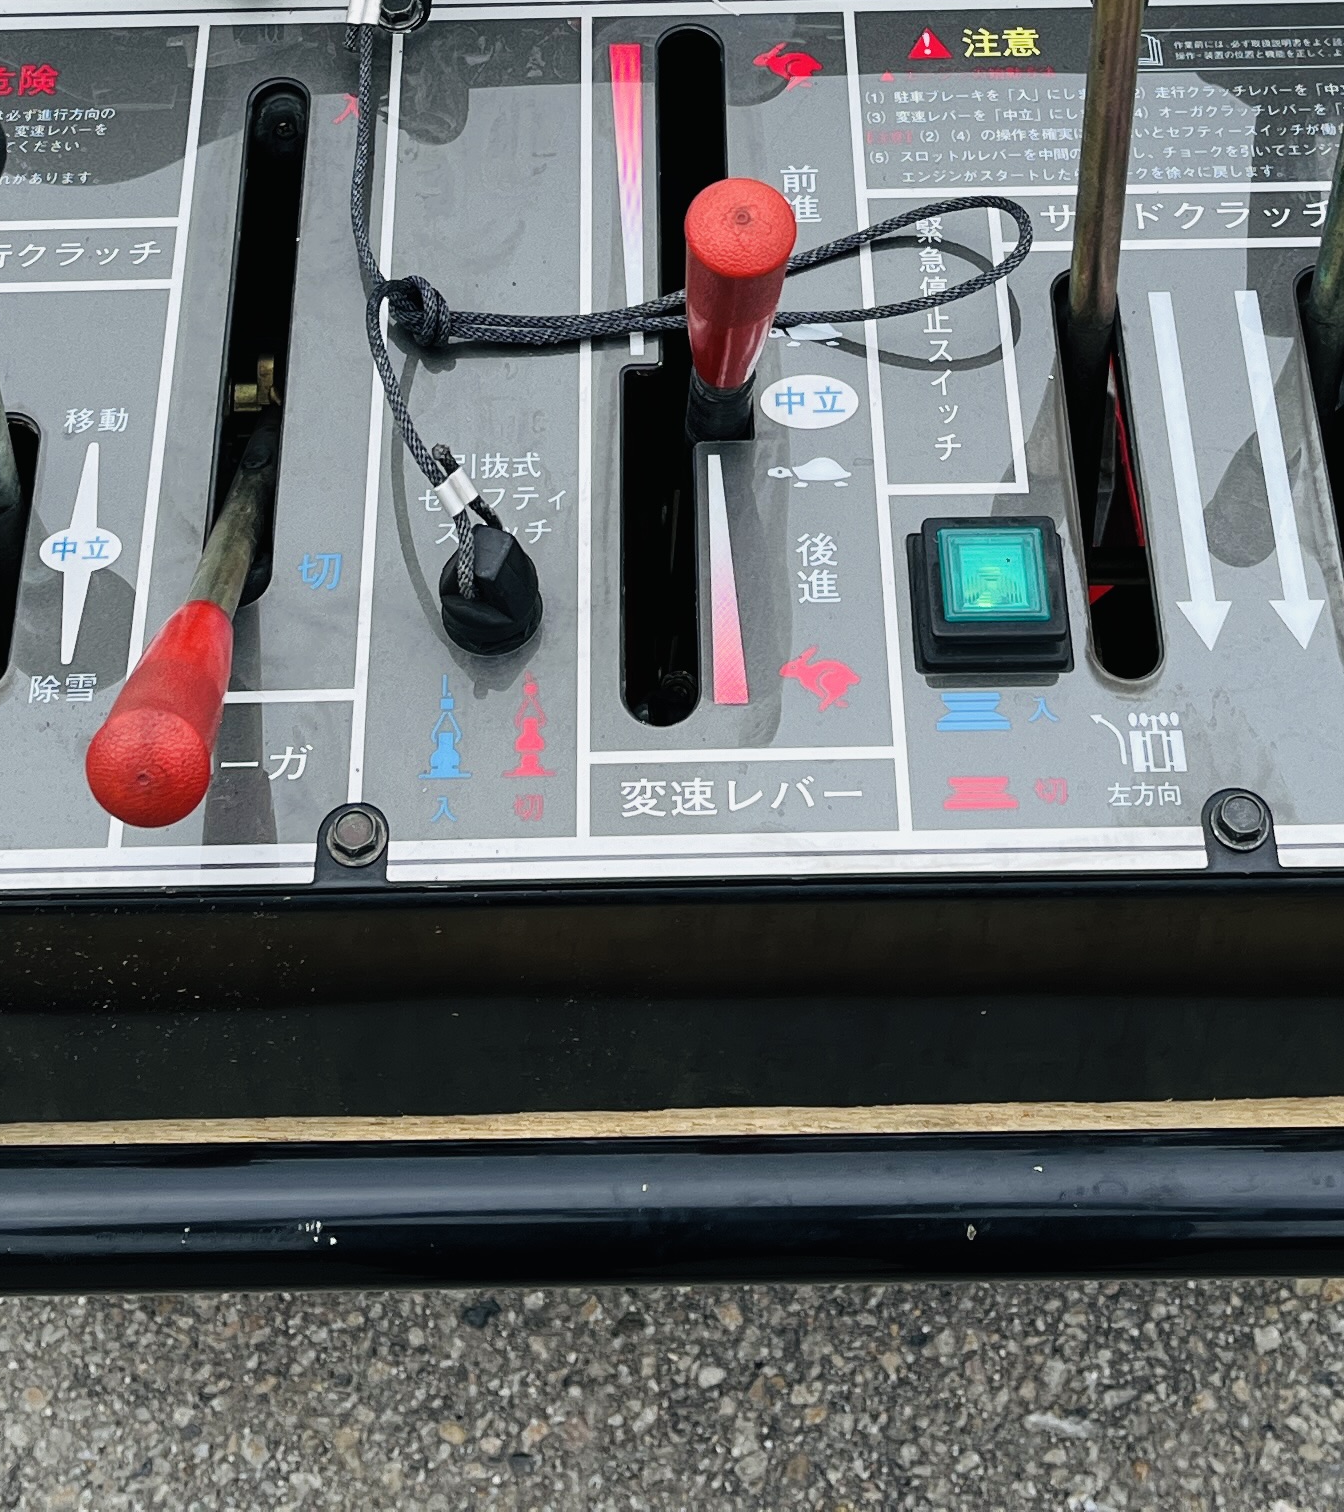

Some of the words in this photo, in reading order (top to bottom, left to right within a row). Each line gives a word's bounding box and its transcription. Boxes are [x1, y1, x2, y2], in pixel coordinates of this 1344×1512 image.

[961, 27, 1041, 58] 注意
[780, 165, 822, 223] 前進
[1040, 199, 1329, 233] サドクラッチ
[915, 217, 962, 462] 緊急停止スイッチ
[773, 386, 847, 415] 中立
[64, 406, 129, 434] 移動
[418, 486, 566, 511] セフティ
[435, 519, 552, 545] スッチ
[50, 535, 110, 562] 中立
[297, 552, 343, 590] 切
[795, 531, 842, 604] 後進
[27, 673, 98, 704] 除雪
[1028, 696, 1059, 724] 入
[218, 744, 313, 782] ーガ
[620, 775, 864, 819] 変速レバー
[1034, 777, 1068, 806] 切
[1108, 781, 1183, 808] 左方向
[432, 796, 456, 822] 入
[514, 795, 544, 822] 切
